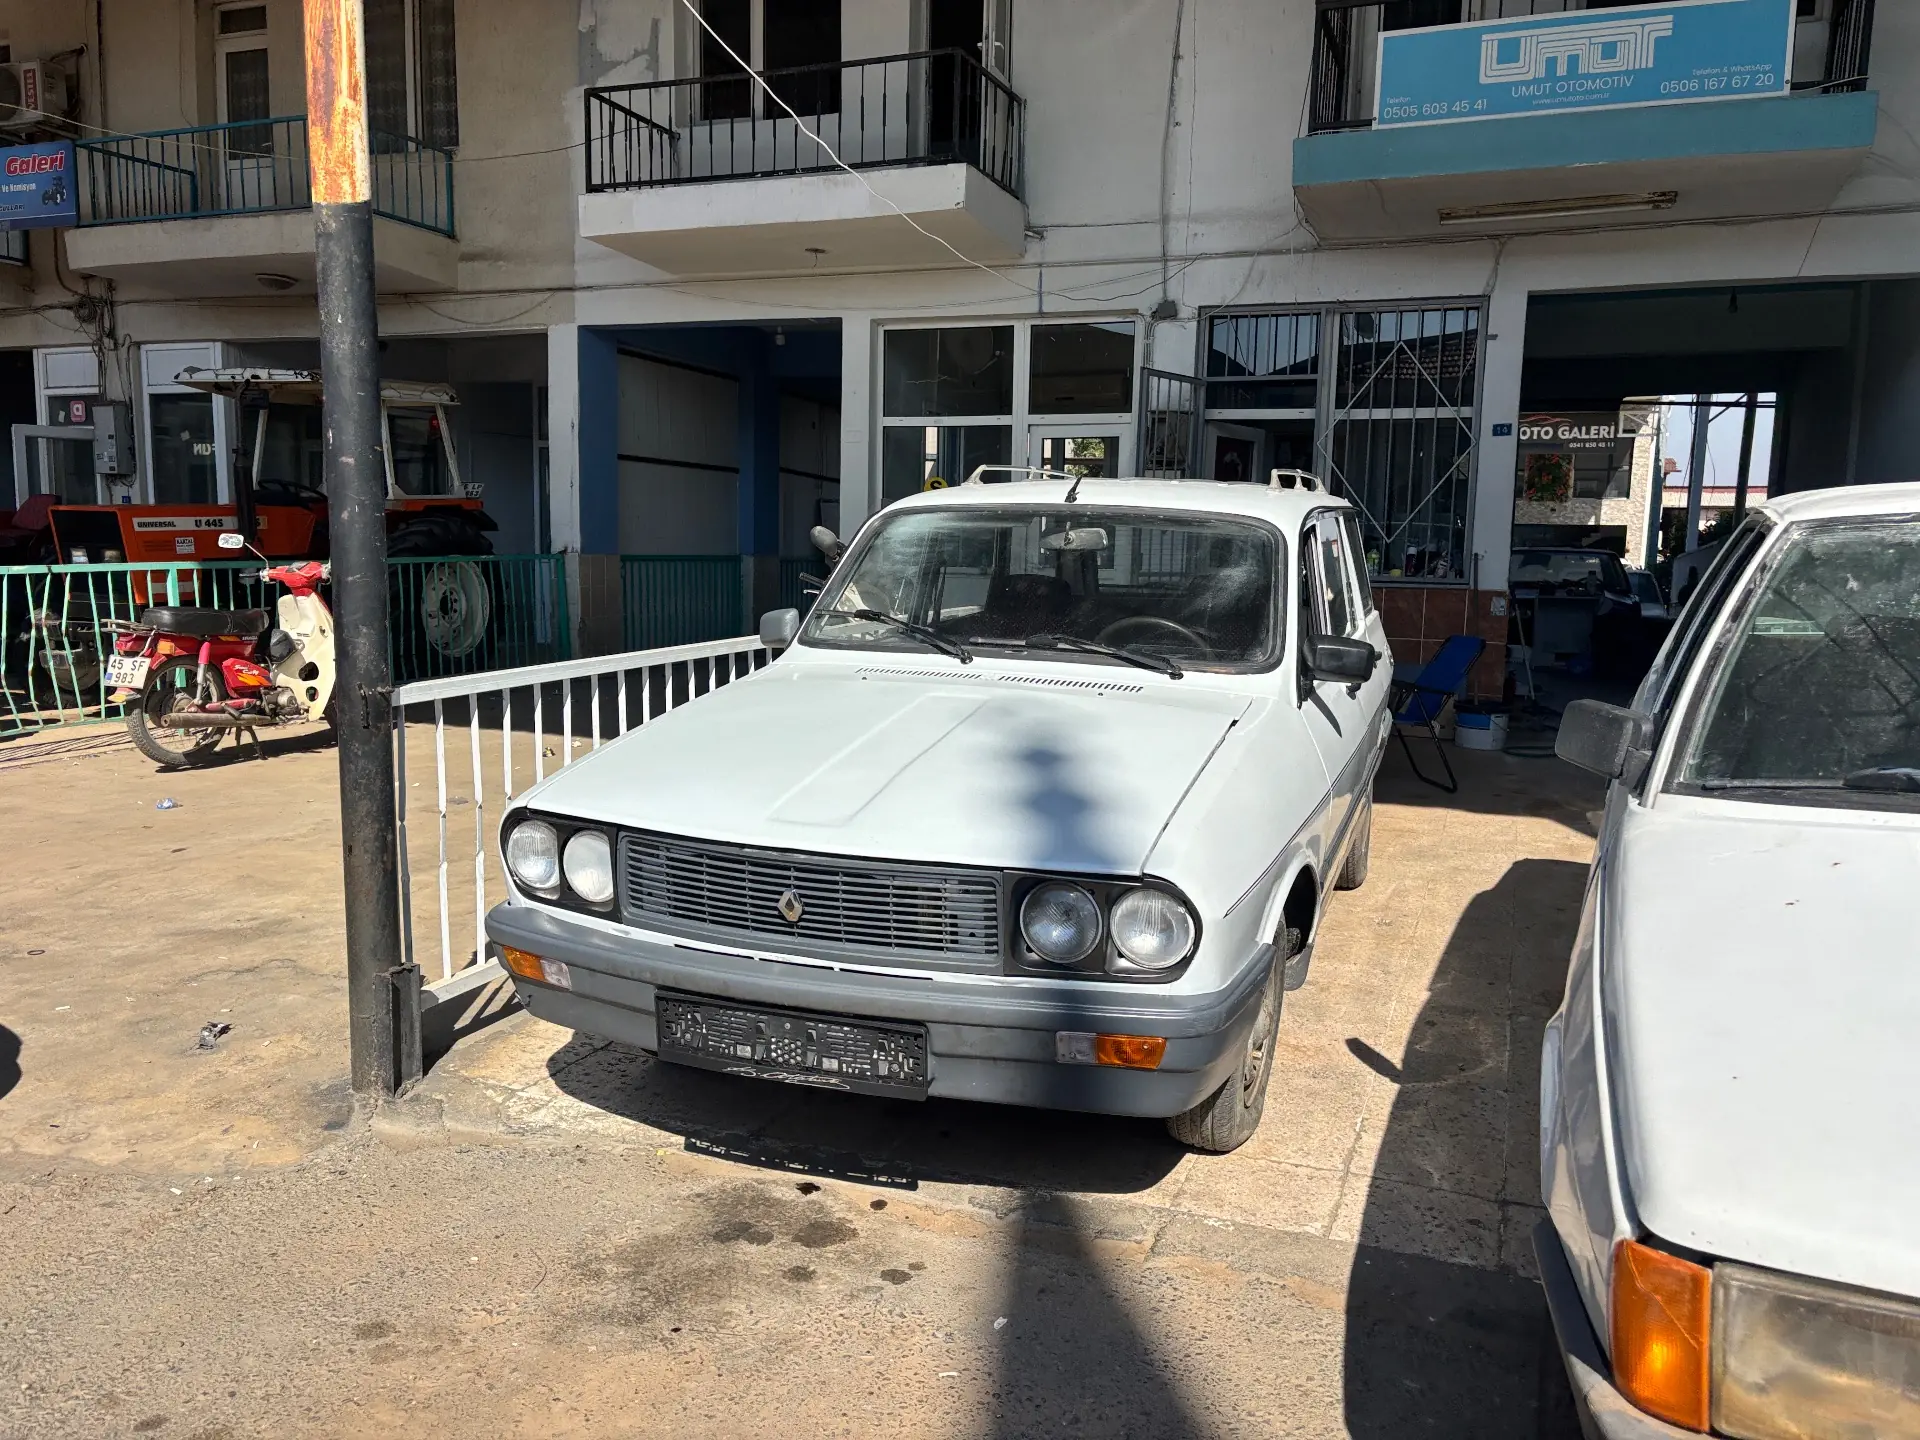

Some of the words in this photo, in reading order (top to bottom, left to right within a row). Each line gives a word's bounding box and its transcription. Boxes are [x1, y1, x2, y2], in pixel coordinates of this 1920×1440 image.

[1730, 64, 1772, 74] WhatsApp
[1512, 82, 1551, 98] UMUT
[1556, 74, 1635, 93] OTOMOTİV
[1660, 79, 1699, 94] 0506
[1704, 77, 1727, 90] 167
[1732, 75, 1751, 88] 67
[1755, 73, 1774, 86] 20
[1386, 96, 1411, 104] Telefon
[1383, 105, 1418, 119] 0505
[1422, 102, 1448, 115] 603
[1451, 100, 1470, 113] 45
[1473, 98, 1487, 111] 41
[6, 151, 65, 176] Galeri
[1519, 425, 1554, 440] OTO
[1557, 422, 1615, 440] GALERİ
[194, 519, 202, 528] U
[204, 518, 224, 528] 445
[110, 658, 124, 670] 45
[130, 660, 146, 672] SF
[114, 672, 135, 684] 983
